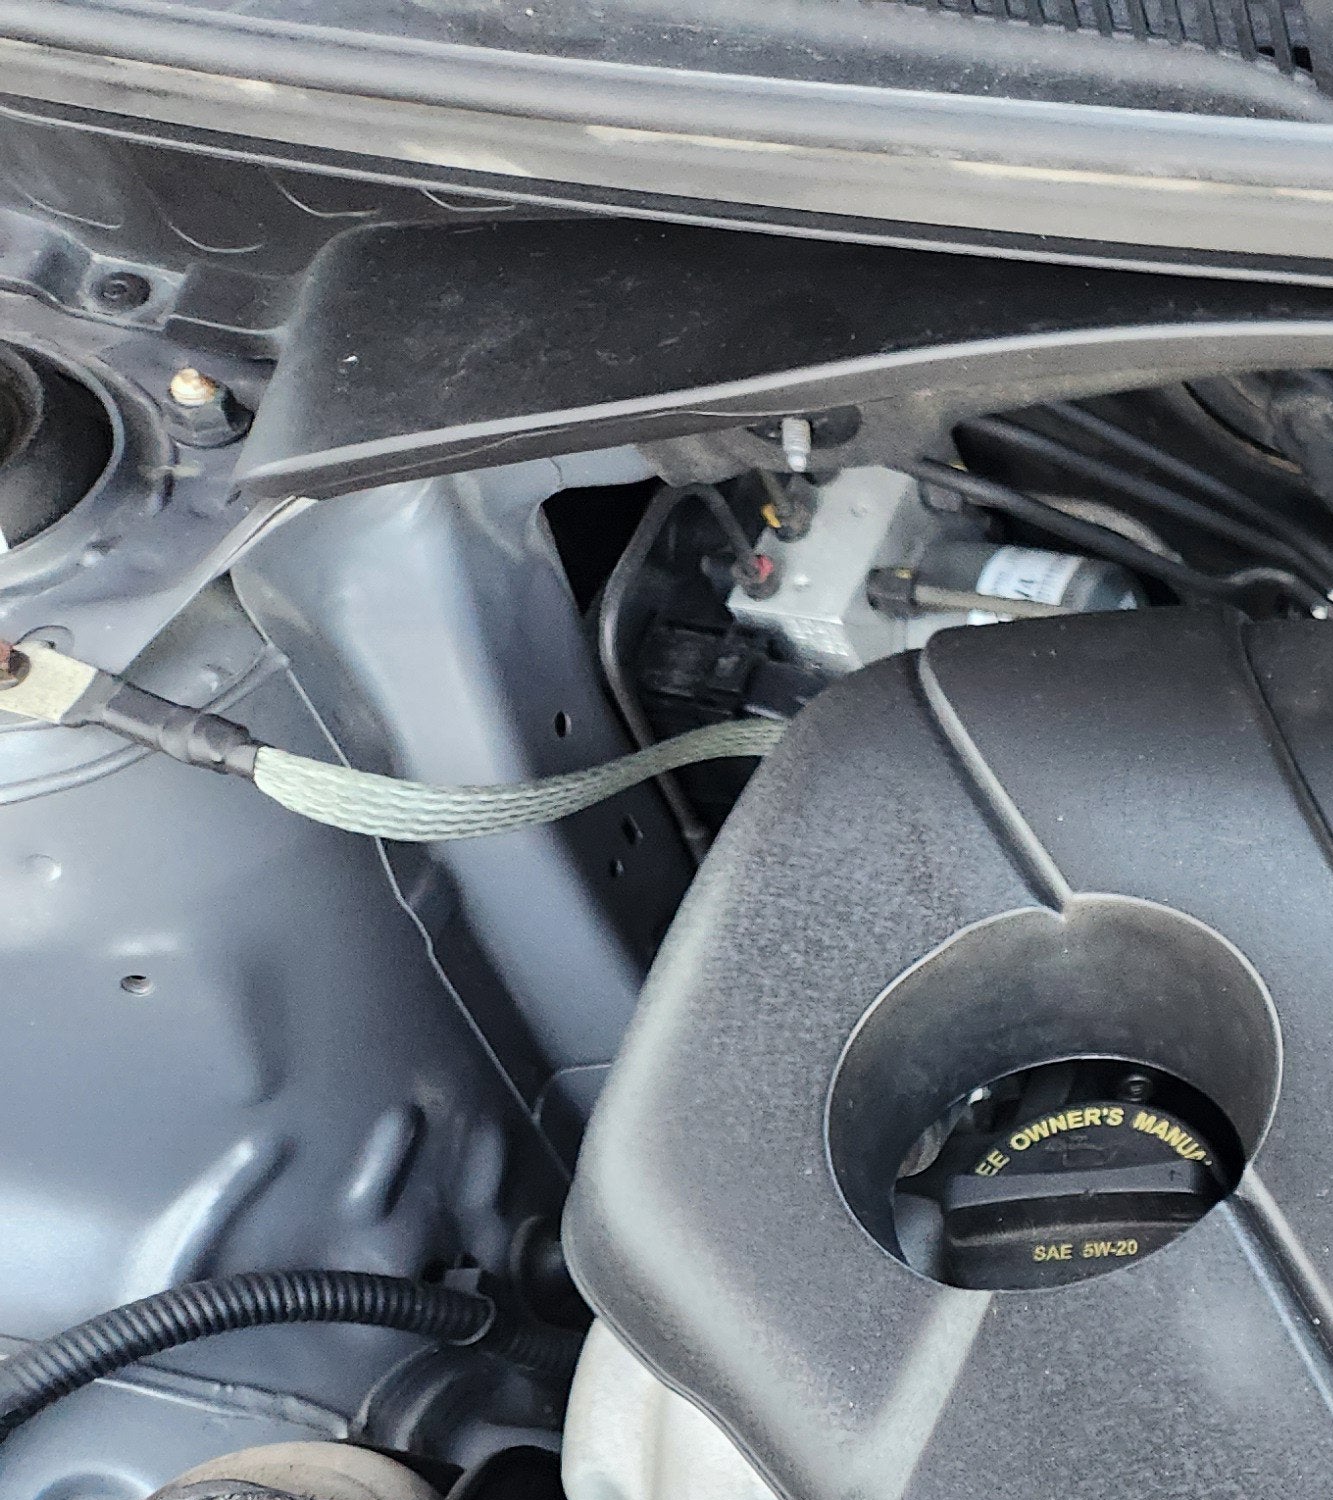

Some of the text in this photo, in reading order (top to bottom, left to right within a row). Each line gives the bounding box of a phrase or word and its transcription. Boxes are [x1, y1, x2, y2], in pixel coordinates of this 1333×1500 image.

[975, 1107, 1213, 1176] EE OWNER'S MANUA
[1033, 1238, 1138, 1262] SAE 5W-20
